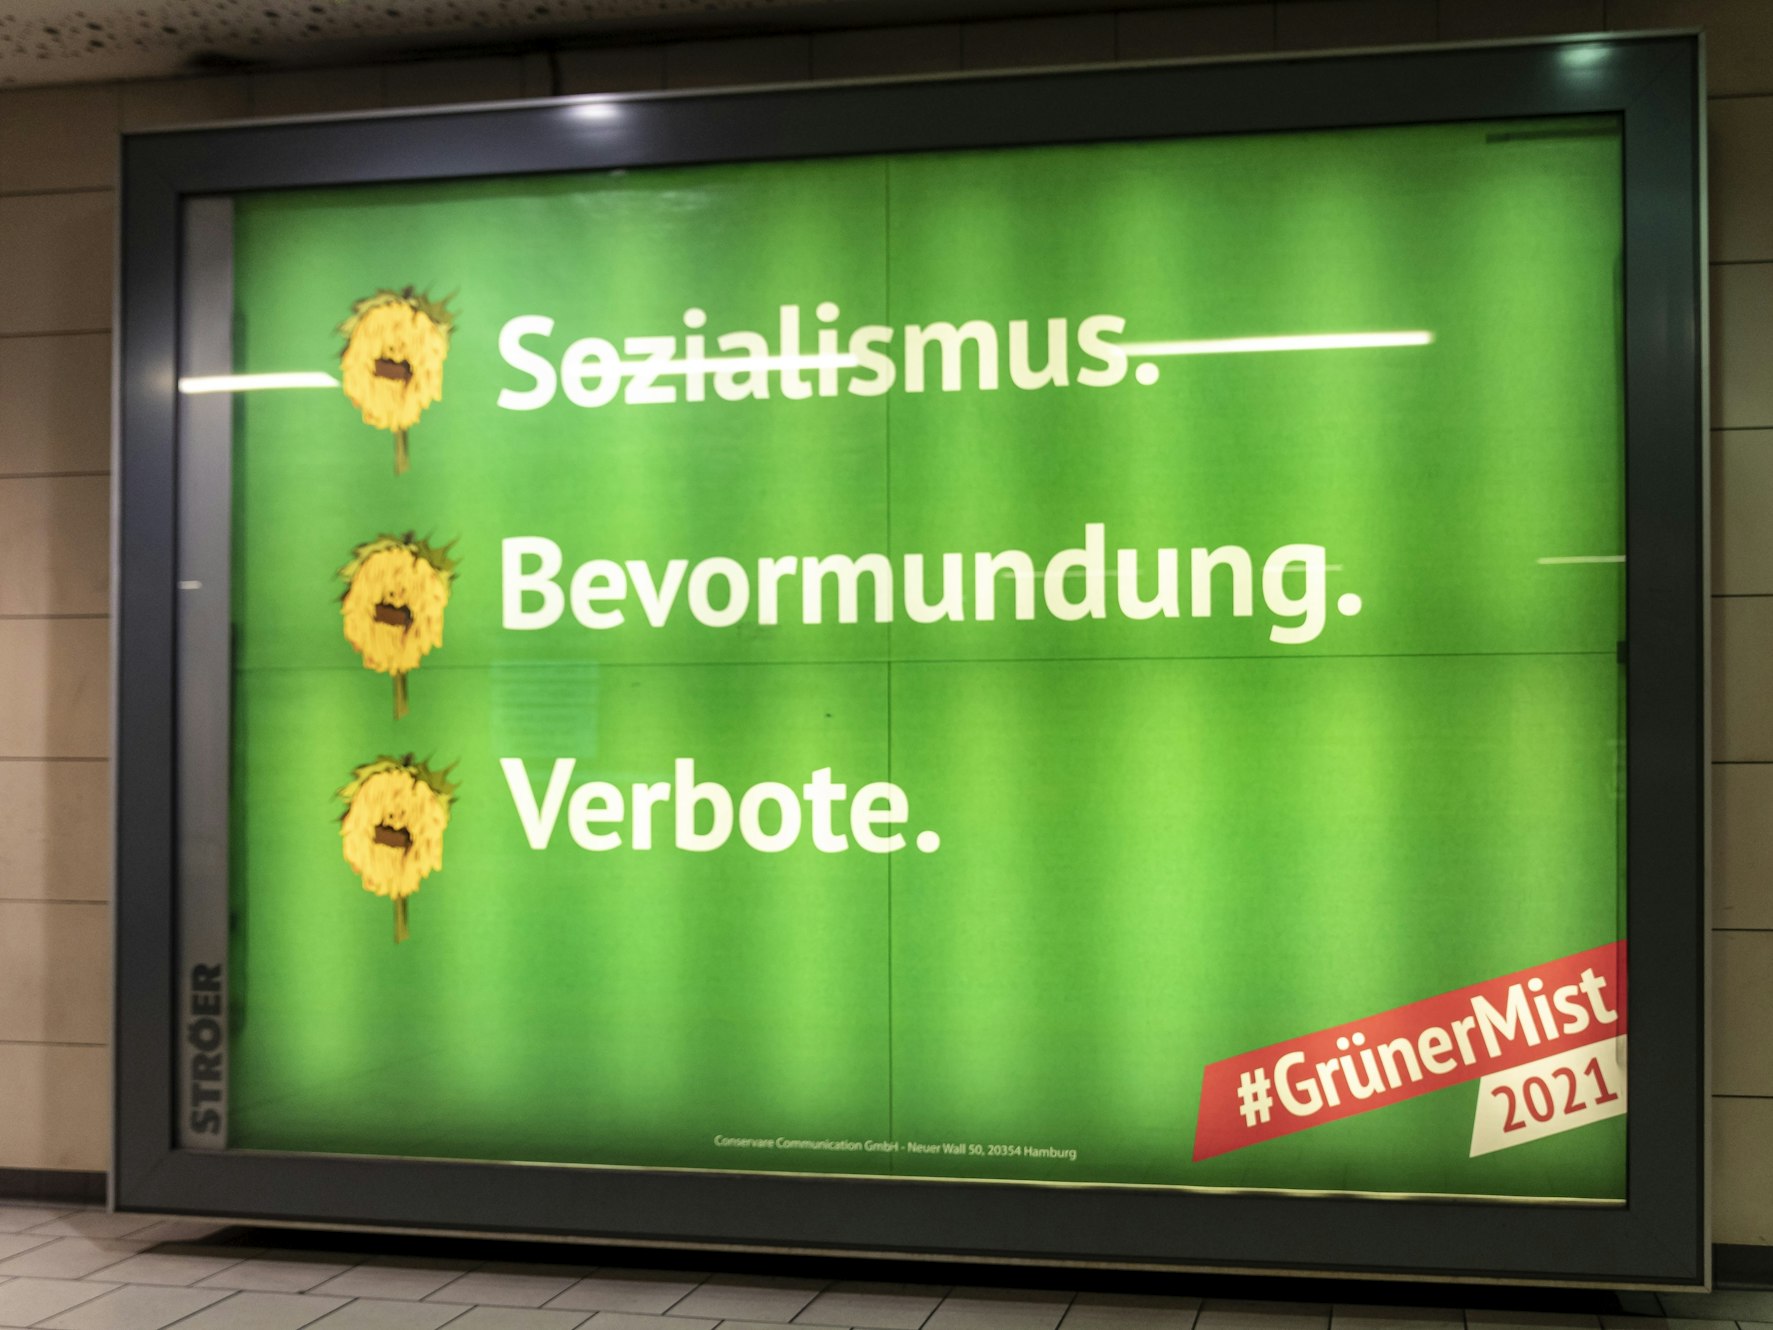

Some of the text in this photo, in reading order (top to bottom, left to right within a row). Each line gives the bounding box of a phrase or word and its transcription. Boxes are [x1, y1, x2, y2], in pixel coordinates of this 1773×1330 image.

[497, 302, 1161, 411] Sozialismus.
[501, 522, 1363, 645] Bevormundung.
[499, 757, 942, 854] Verbote.
[188, 963, 222, 1136] STRÖER
[1237, 967, 1619, 1128] #GrünerMist
[1490, 1056, 1619, 1134] 2021
[713, 1134, 775, 1149] Conservare
[775, 1137, 863, 1151] Communication
[863, 1139, 899, 1152] GmbH
[907, 1141, 941, 1153] Neuer
[942, 1143, 967, 1155] Wall
[968, 1143, 986, 1156] 50,
[987, 1144, 1022, 1157] 20354
[1023, 1146, 1078, 1161] Hamburg
